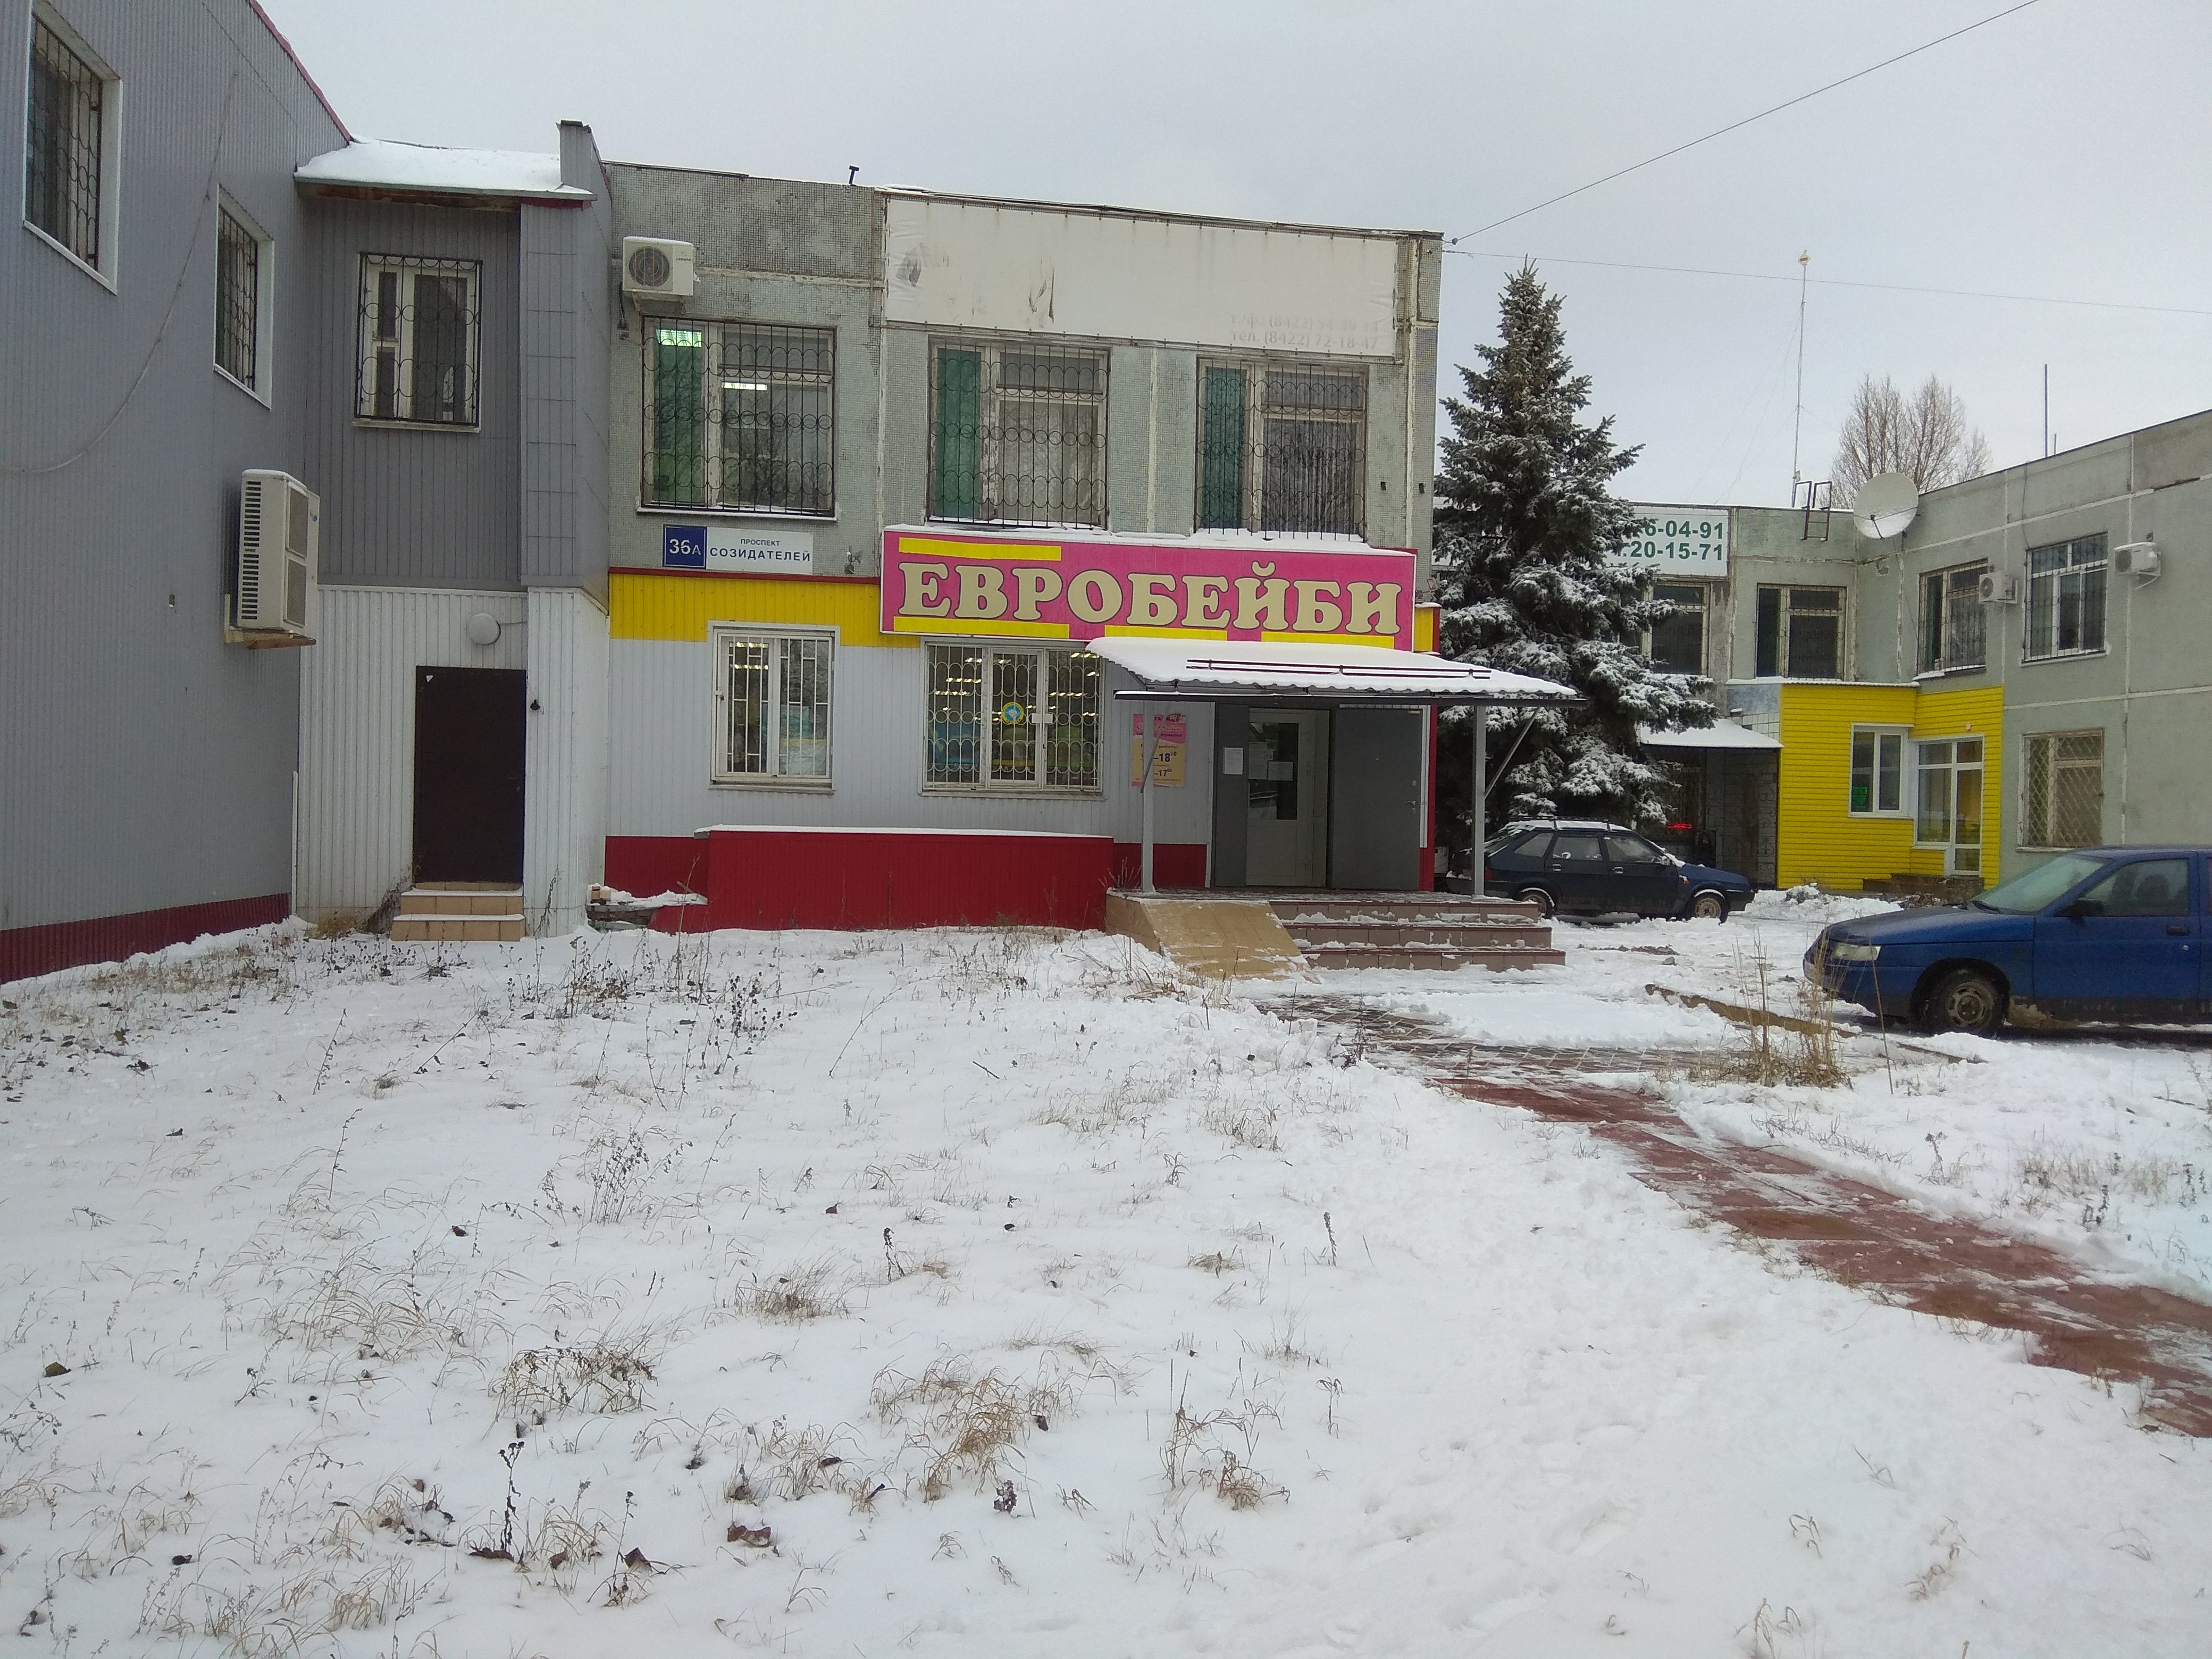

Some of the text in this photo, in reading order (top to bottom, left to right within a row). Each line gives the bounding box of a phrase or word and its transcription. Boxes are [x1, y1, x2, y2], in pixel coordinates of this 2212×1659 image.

[1264, 330, 1310, 347] (8422)
[1316, 334, 1378, 349] 72-18-47
[669, 538, 701, 555] 36А
[740, 538, 781, 547] ПРОСПЕКТ
[710, 547, 810, 562] СОЗИДАТЕЛЕЙ
[898, 560, 1403, 635] ЕВРОБЕЙБИ
